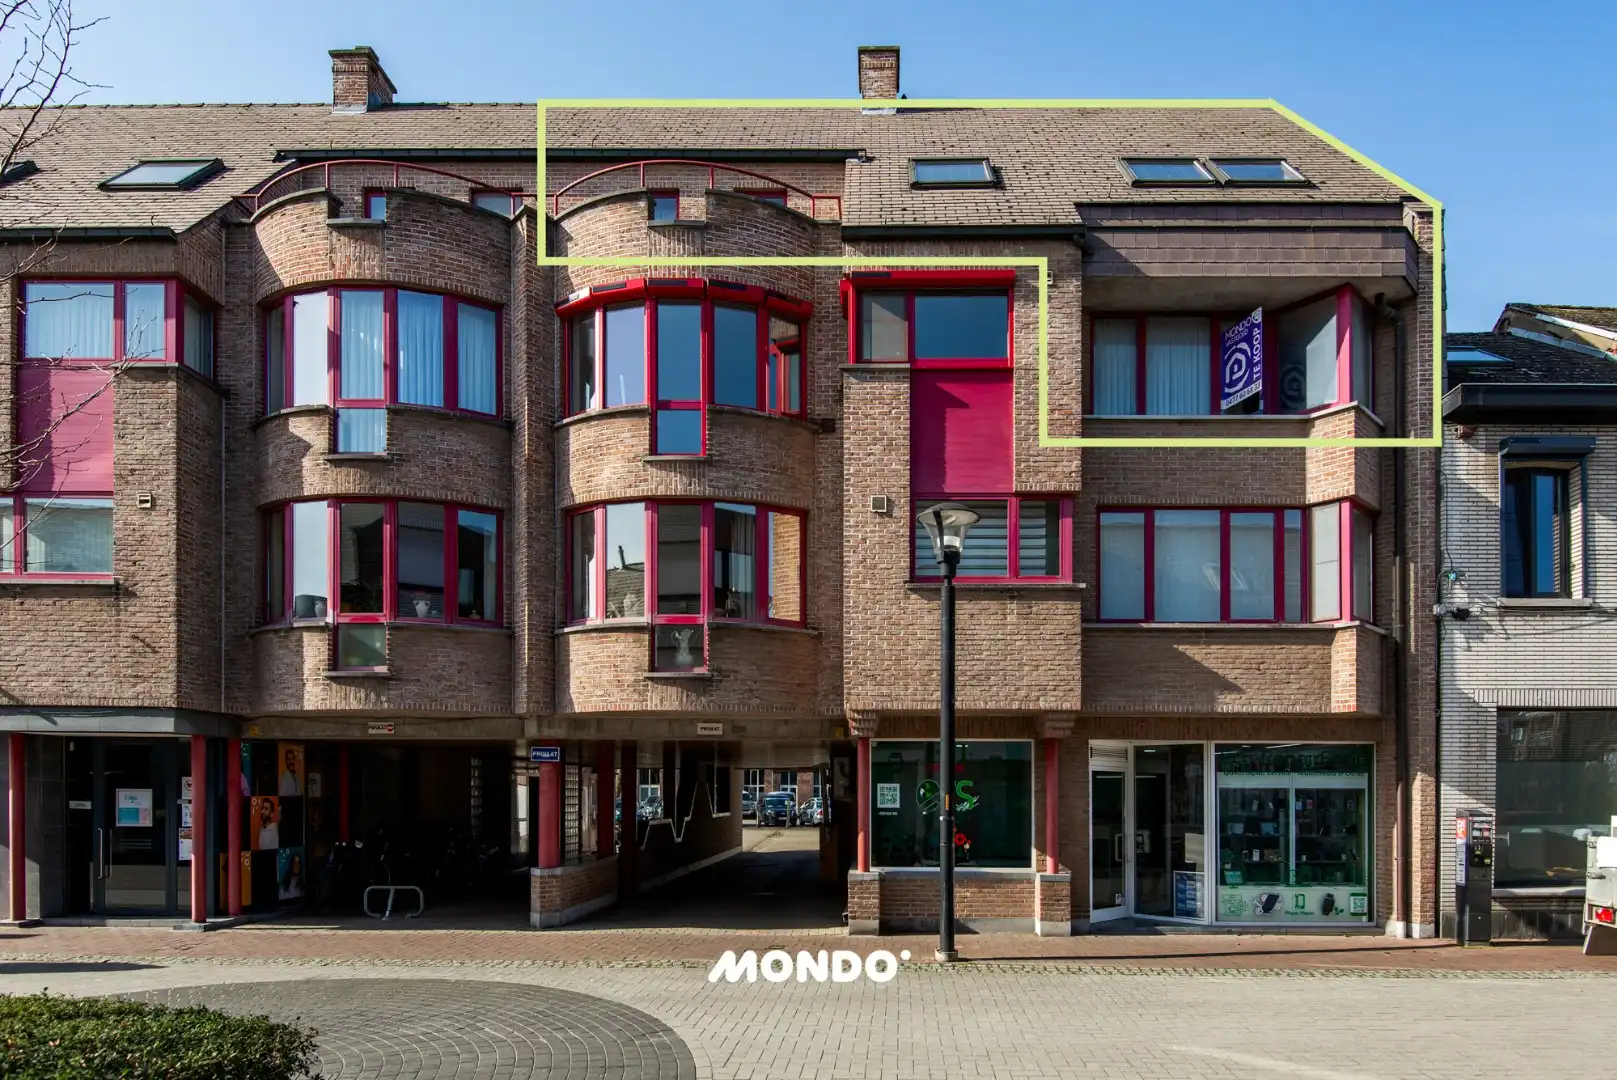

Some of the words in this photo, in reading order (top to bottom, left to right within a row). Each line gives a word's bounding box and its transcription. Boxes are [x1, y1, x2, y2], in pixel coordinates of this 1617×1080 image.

[1225, 316, 1252, 341] MONDO
[1252, 327, 1261, 363] KOOP
[1252, 363, 1261, 381] TE
